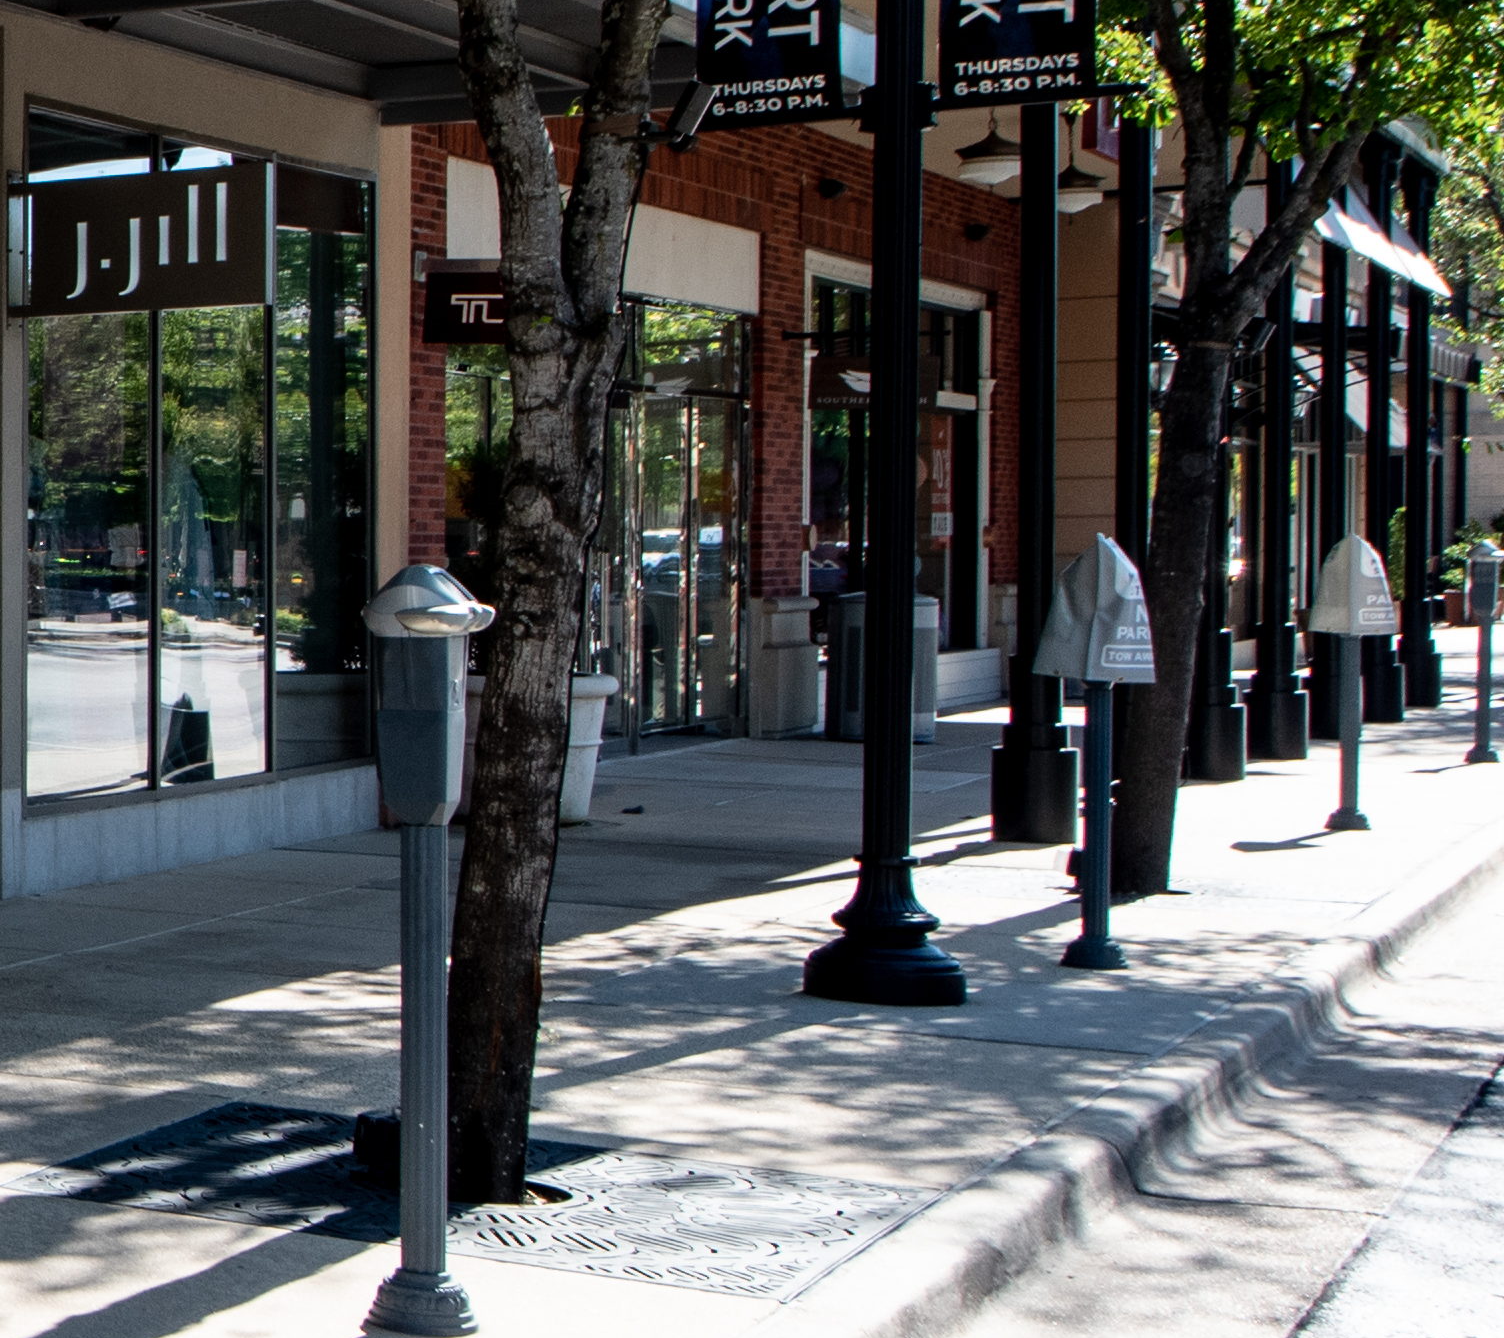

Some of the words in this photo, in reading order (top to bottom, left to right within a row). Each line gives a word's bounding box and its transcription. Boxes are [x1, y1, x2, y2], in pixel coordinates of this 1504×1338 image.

[955, 53, 1080, 76] THURSDAYS
[714, 73, 826, 96] THURSDAYS
[954, 76, 1031, 96] 6-8:30
[1036, 73, 1083, 89] P.M.
[712, 96, 782, 116] 6-8:30
[787, 93, 830, 110] P.M.
[816, 396, 870, 404] SOUTHE
